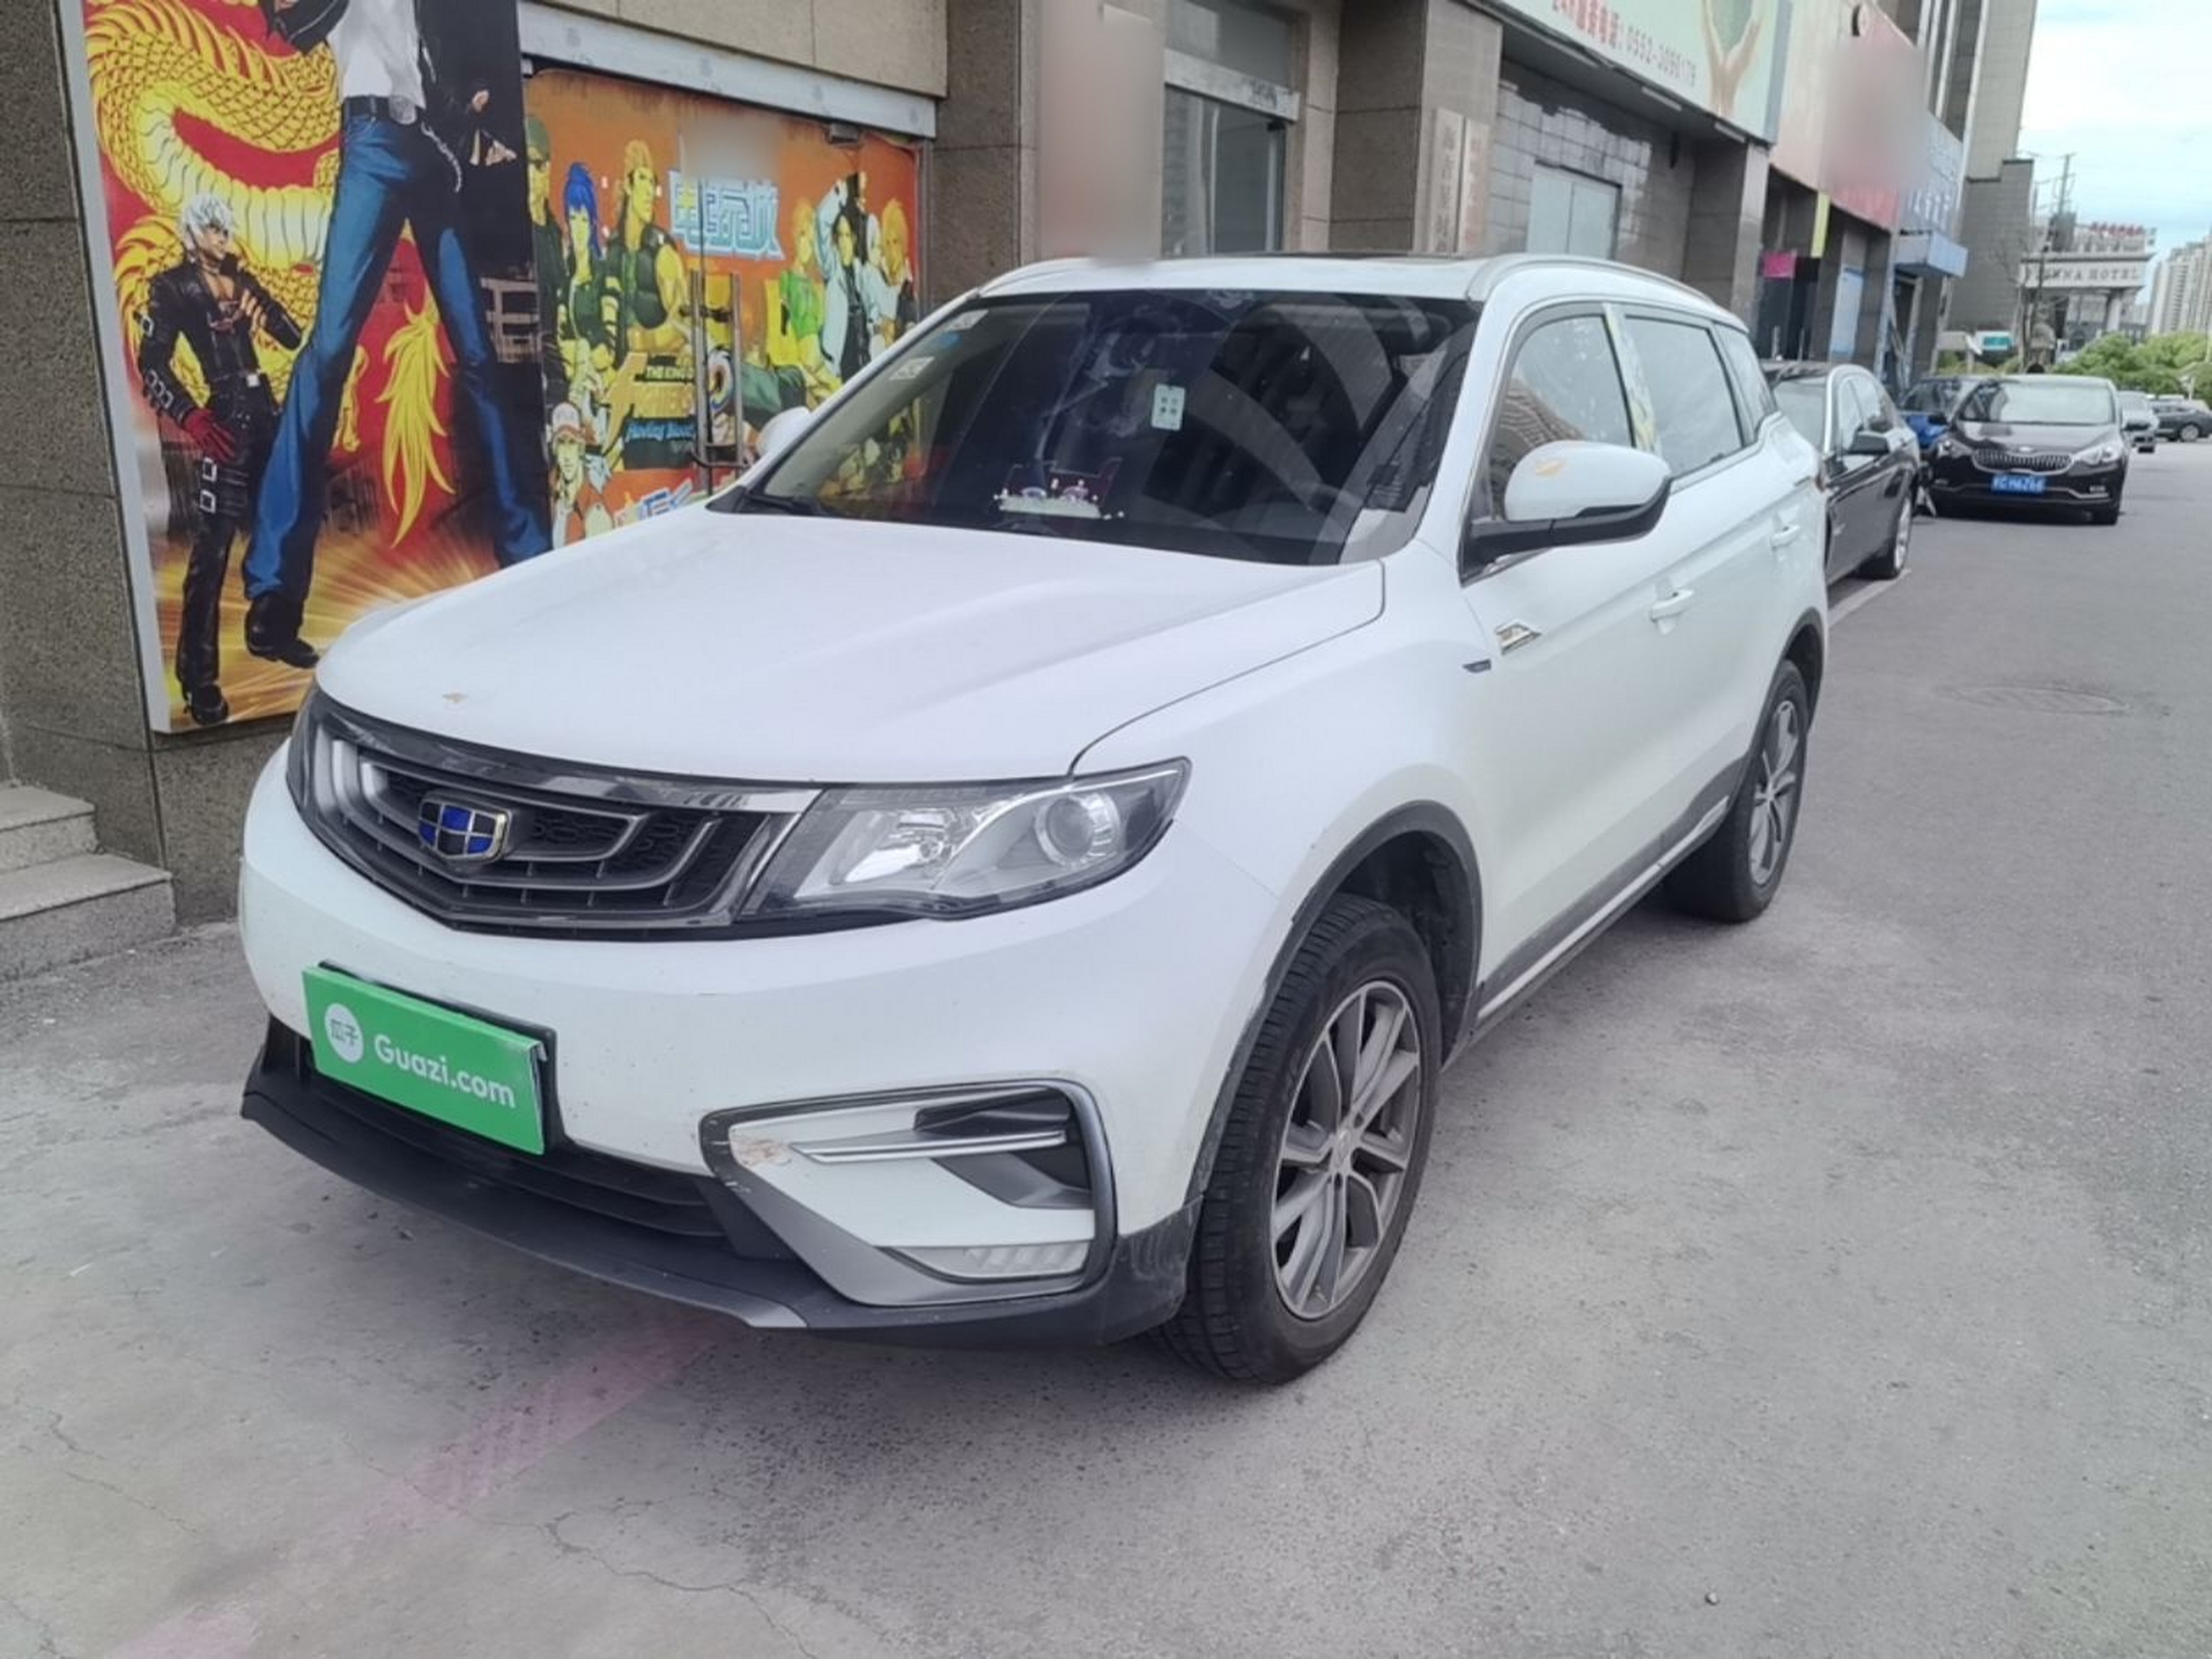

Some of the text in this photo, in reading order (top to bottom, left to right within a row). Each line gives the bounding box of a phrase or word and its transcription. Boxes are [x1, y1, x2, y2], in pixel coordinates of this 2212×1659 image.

[2088, 267, 2138, 281] HOTEL
[329, 1018, 359, 1047] 瓜子
[374, 1034, 516, 1108] Guazi.com
